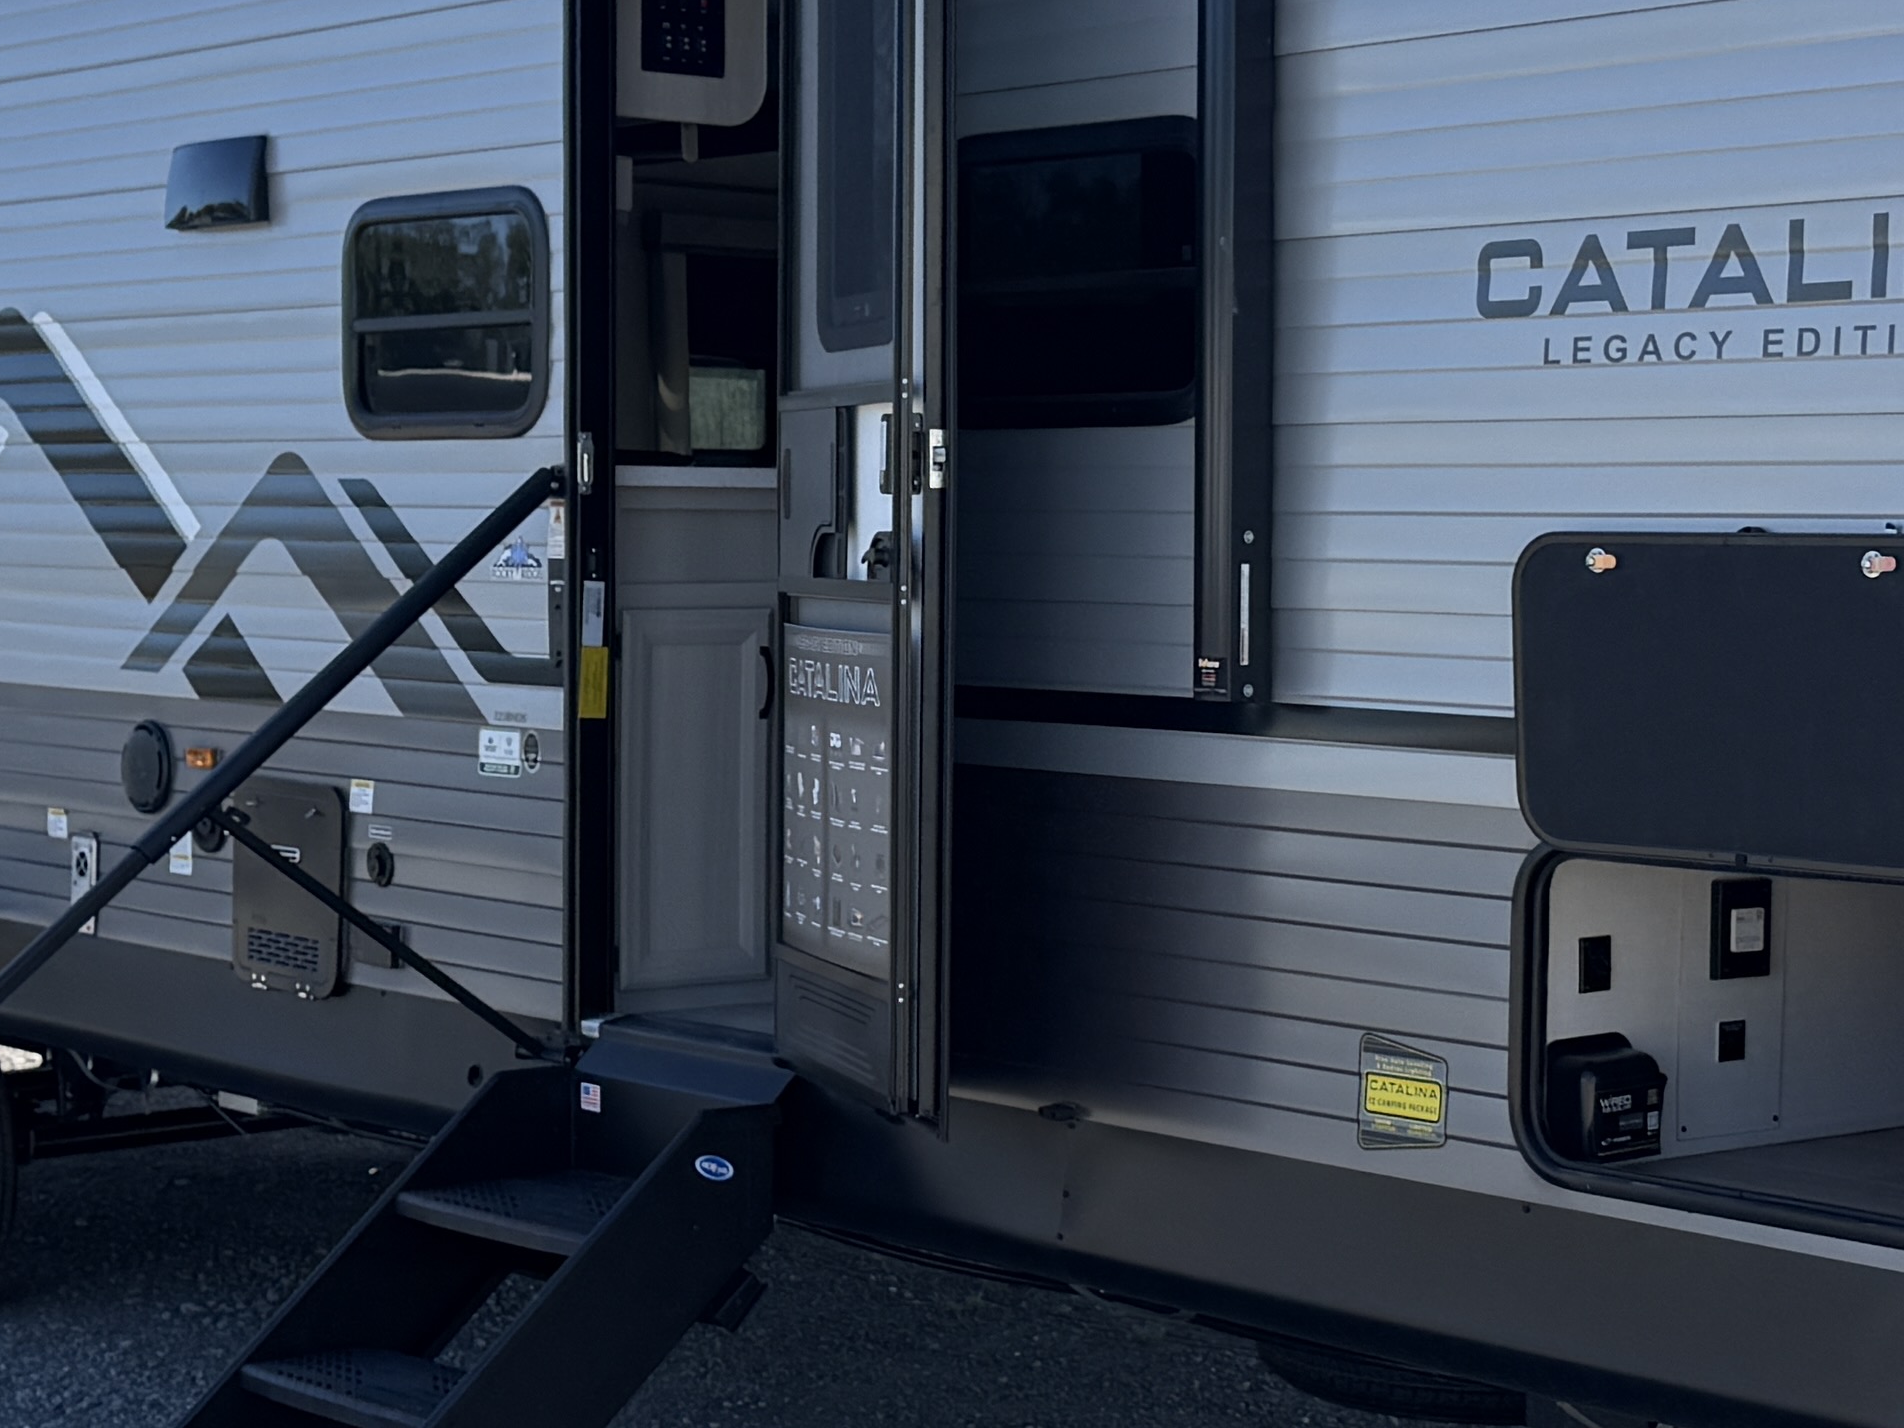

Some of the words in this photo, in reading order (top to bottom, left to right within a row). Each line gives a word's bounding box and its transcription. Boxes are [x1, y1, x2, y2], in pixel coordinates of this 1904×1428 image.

[1543, 330, 1733, 365] LEGACY
[789, 656, 880, 707] CATALINA
[1370, 1079, 1438, 1099] CATALINA
